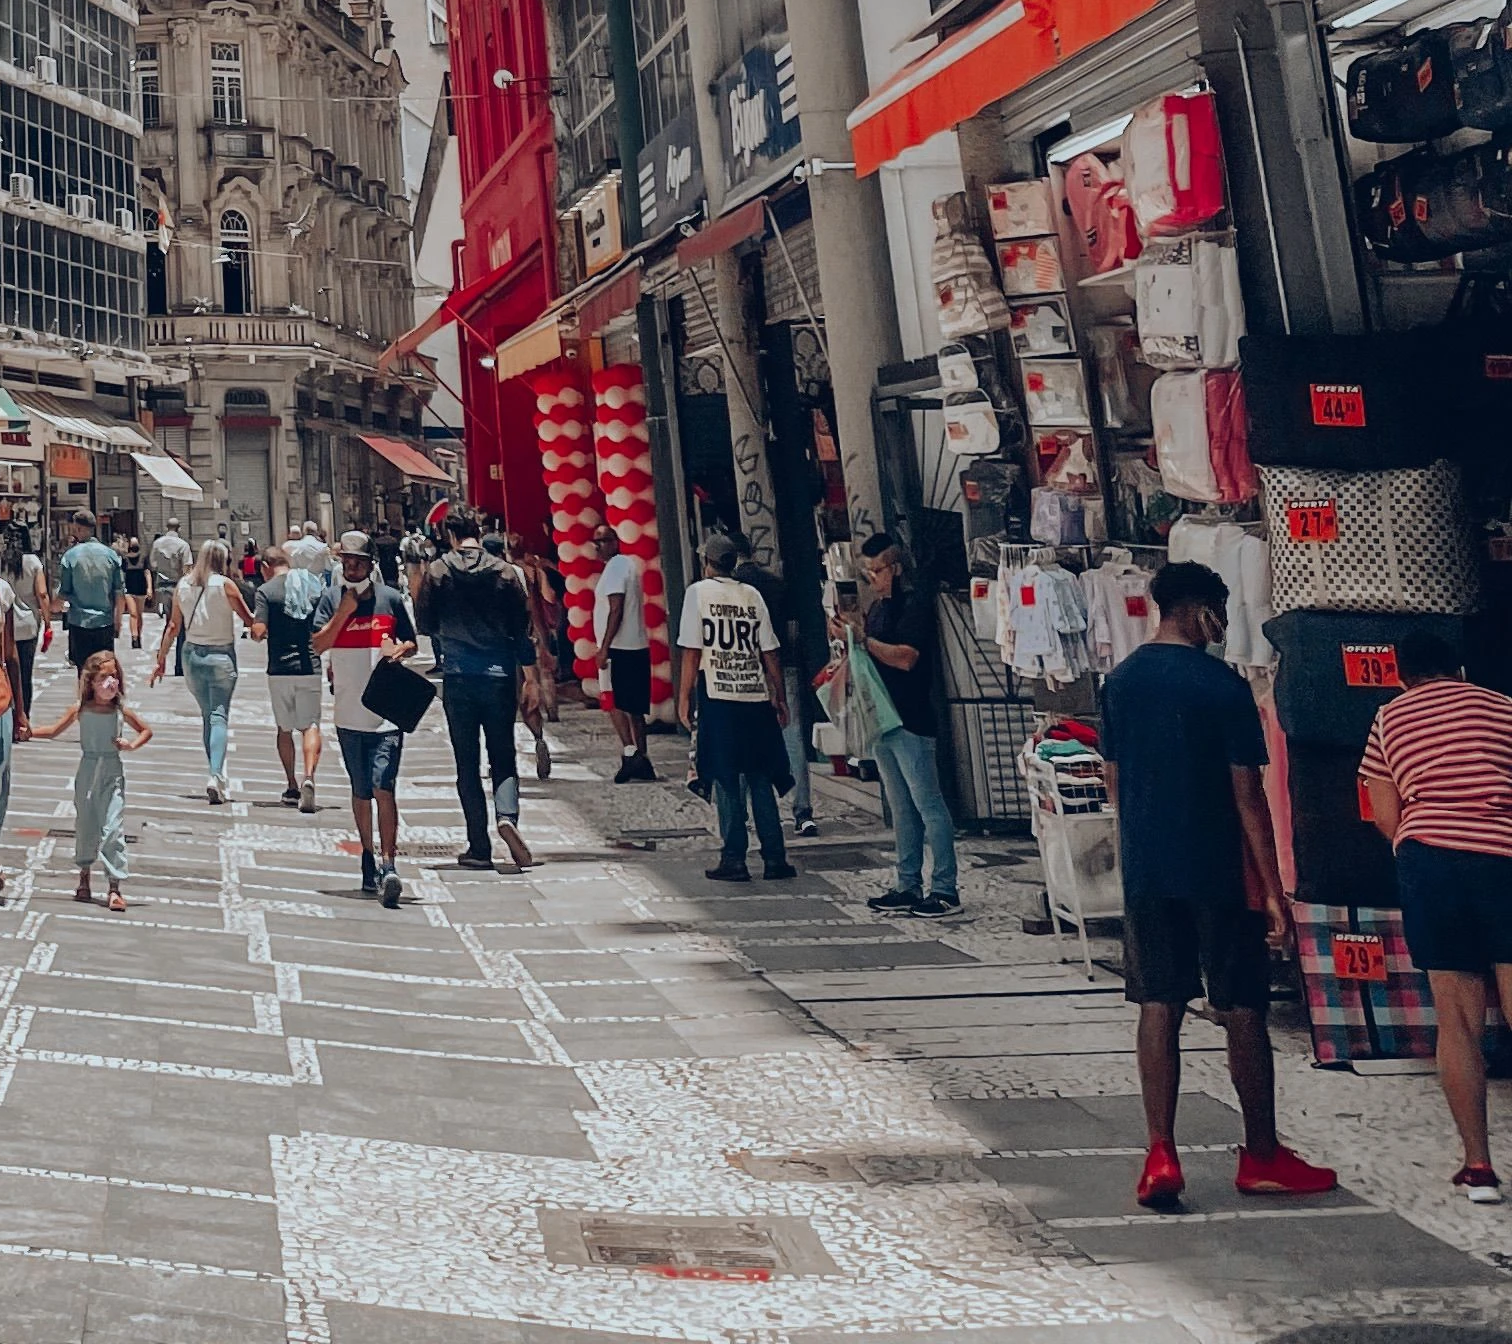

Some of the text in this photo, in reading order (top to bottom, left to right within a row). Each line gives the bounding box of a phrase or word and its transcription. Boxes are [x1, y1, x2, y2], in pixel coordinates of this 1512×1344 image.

[1315, 385, 1359, 393] OFERTA
[1291, 500, 1330, 508] OFERTA
[709, 603, 758, 620] COMPRA-SE
[1346, 645, 1390, 653] OFERTA
[1335, 934, 1379, 943] OFERTA
